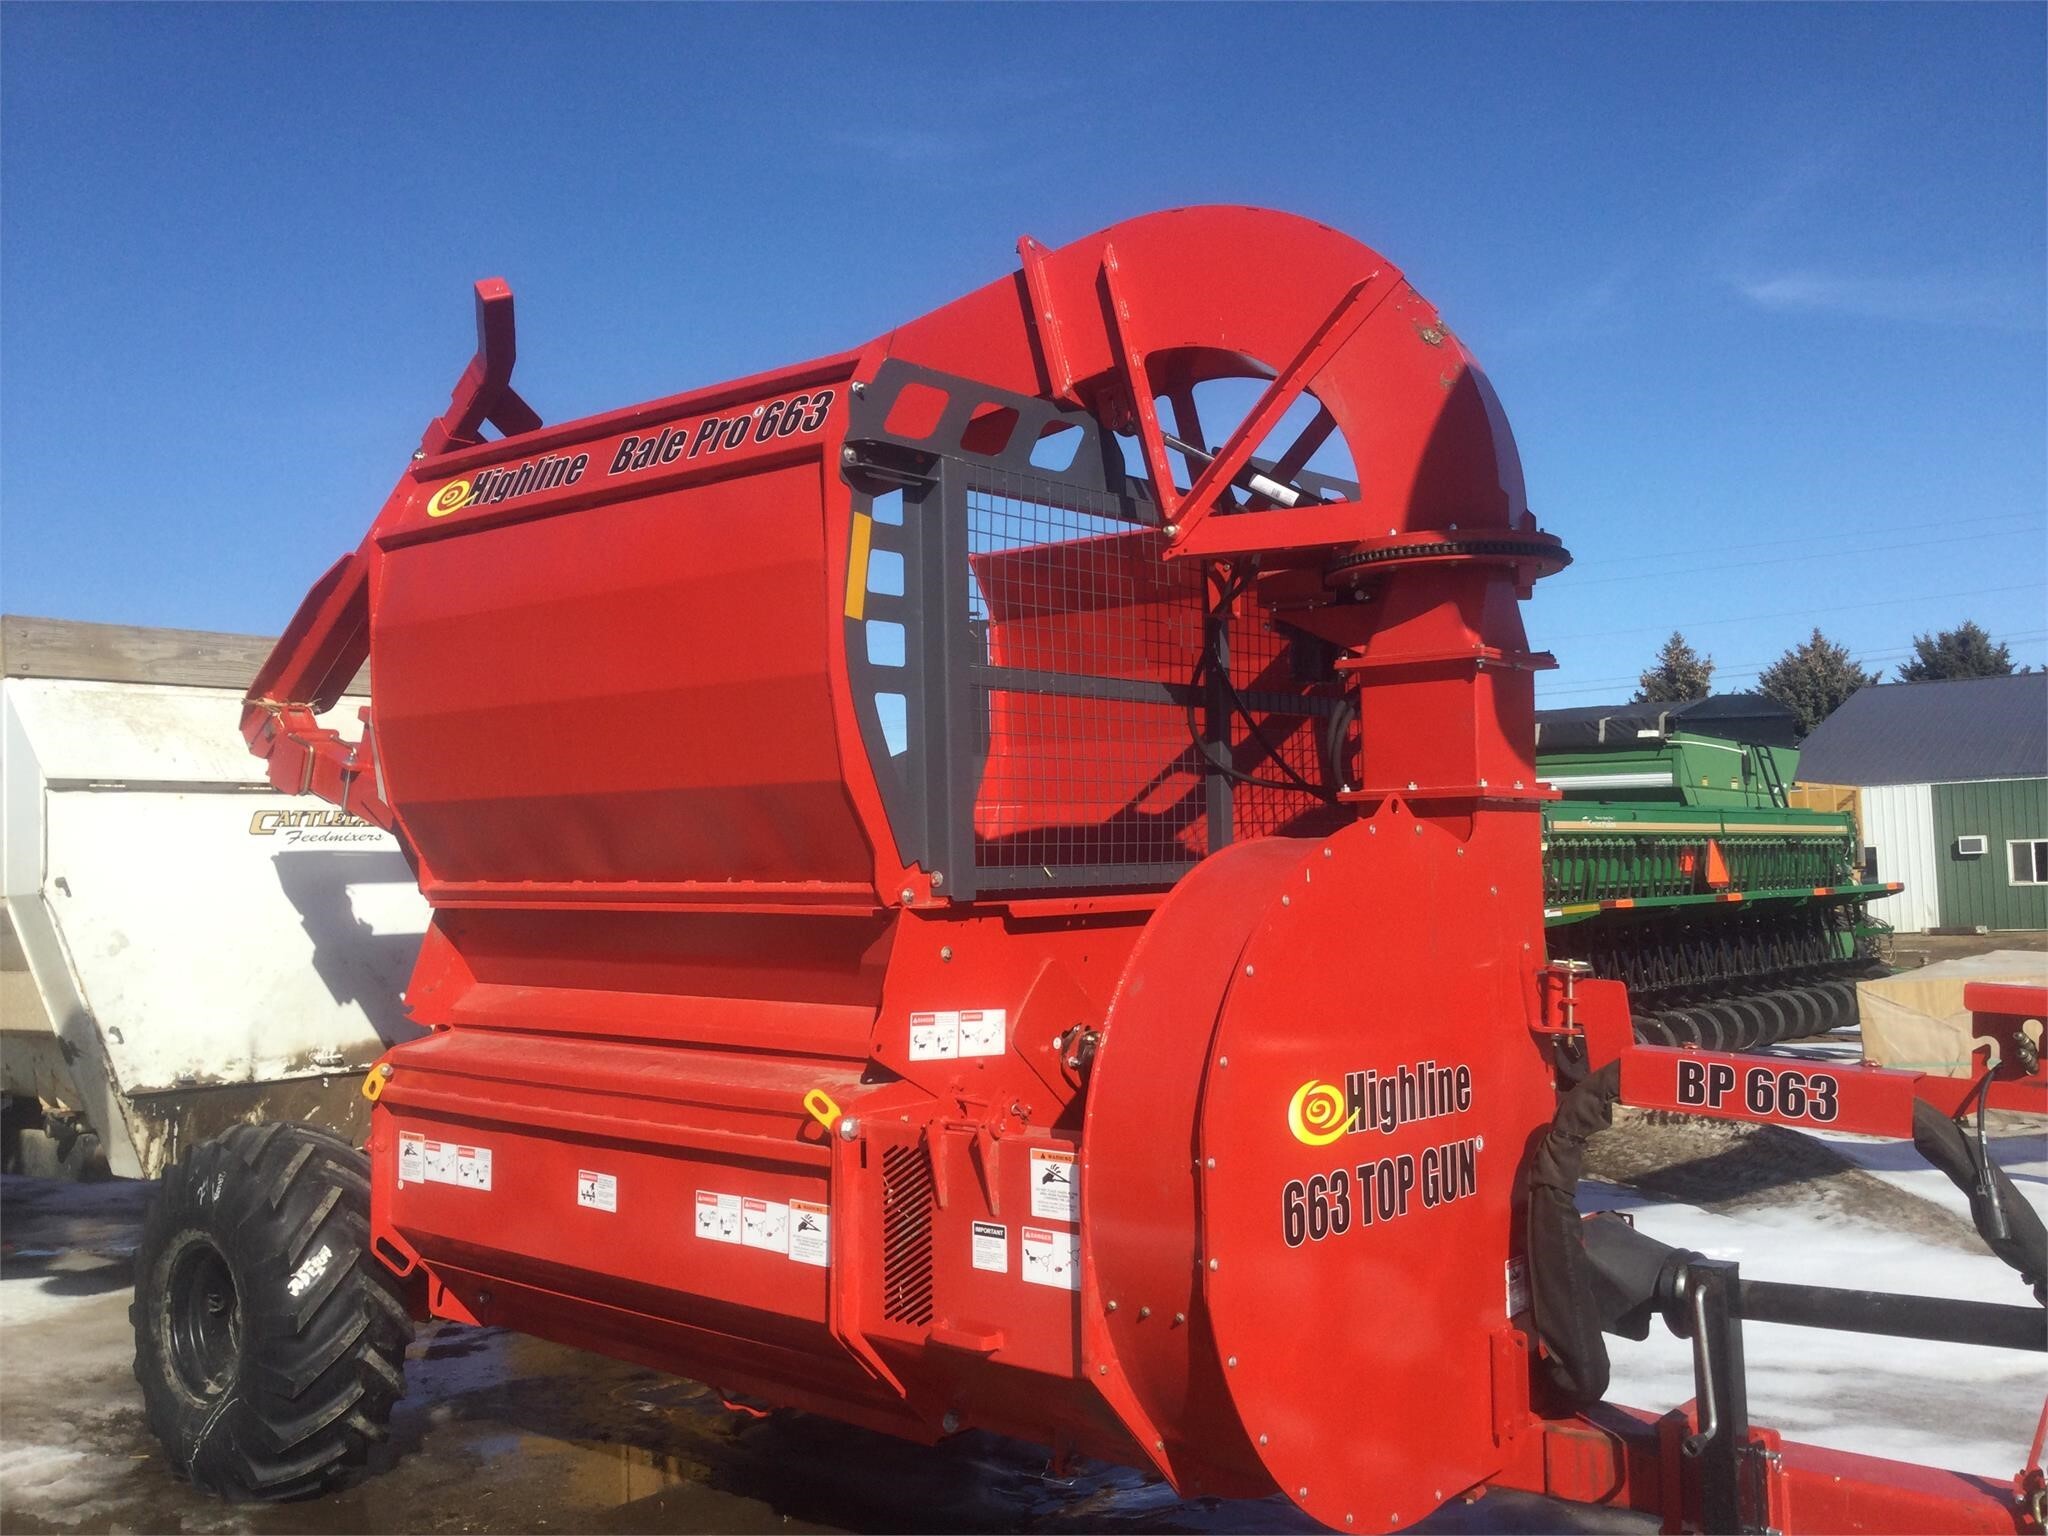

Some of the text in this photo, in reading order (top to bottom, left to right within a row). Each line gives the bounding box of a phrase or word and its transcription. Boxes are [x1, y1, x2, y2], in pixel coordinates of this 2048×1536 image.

[608, 390, 835, 475] Bale Pro 663
[463, 453, 590, 508] Highline
[285, 831, 384, 845] Feedmixers
[1345, 1060, 1472, 1135] Highline
[1677, 1060, 1839, 1123] BP 663
[1282, 1138, 1477, 1249] 663 TOP GUN
[975, 1226, 1004, 1236] IMPORTANT
